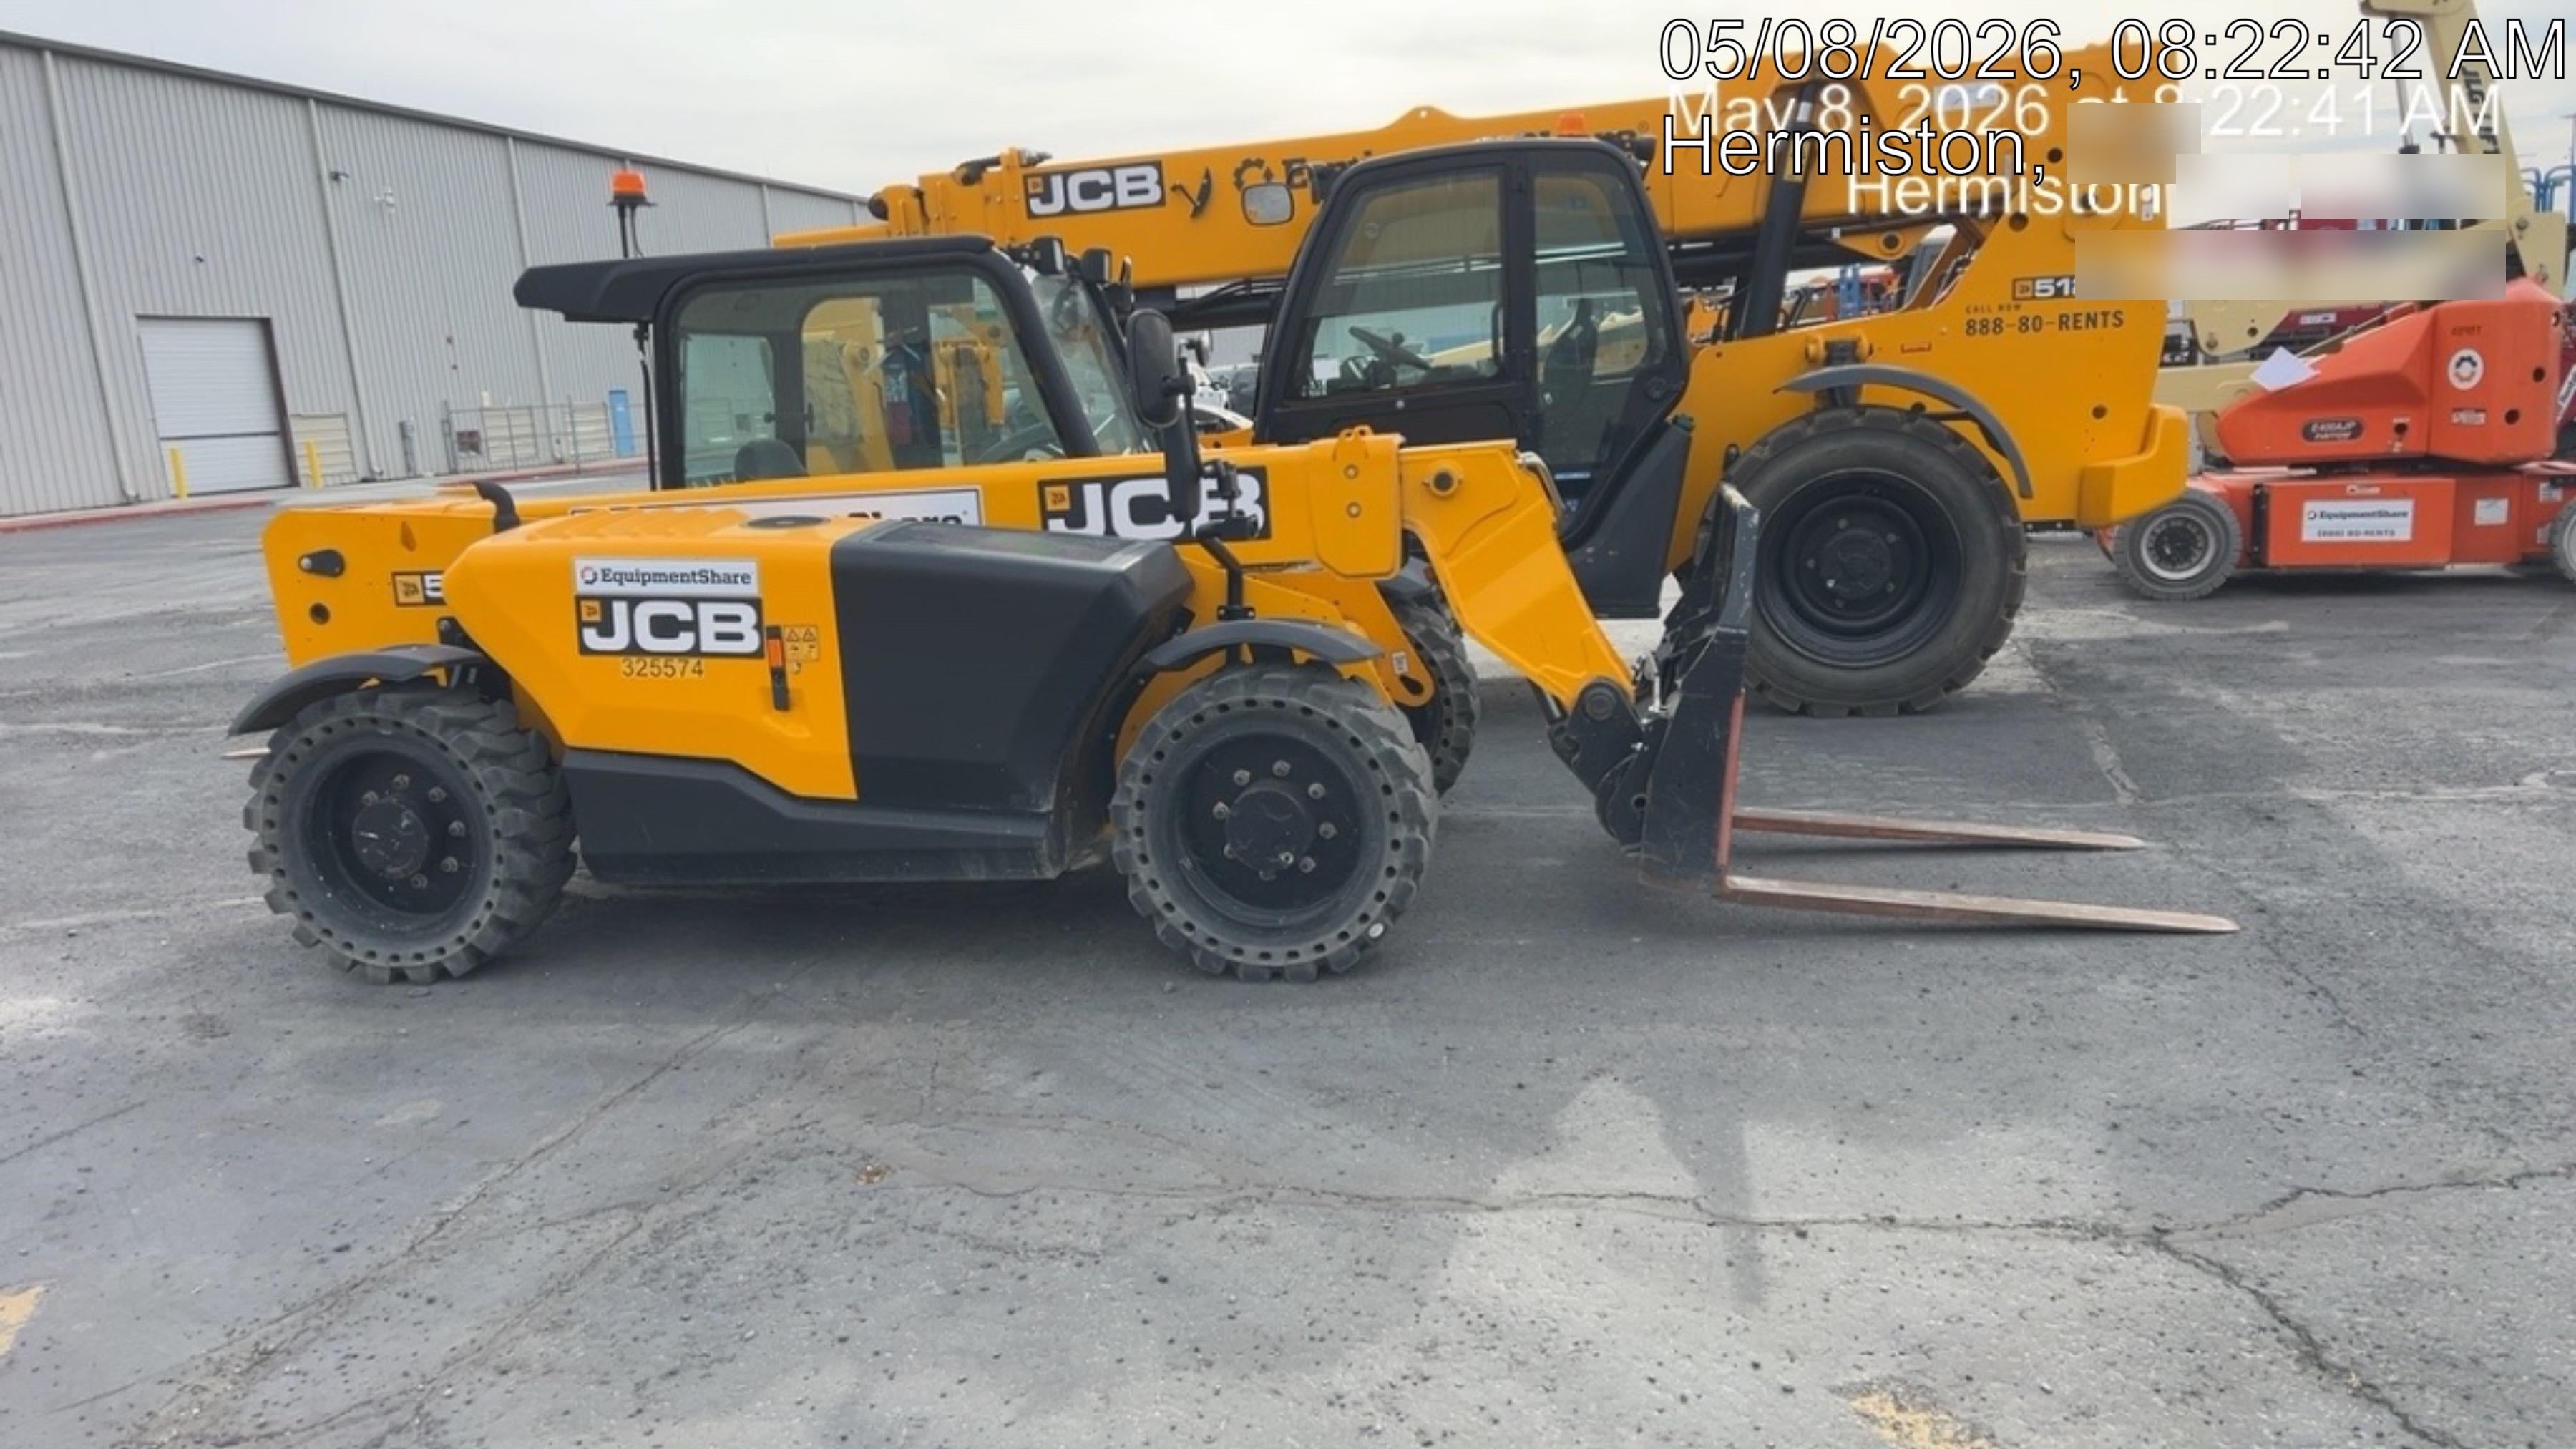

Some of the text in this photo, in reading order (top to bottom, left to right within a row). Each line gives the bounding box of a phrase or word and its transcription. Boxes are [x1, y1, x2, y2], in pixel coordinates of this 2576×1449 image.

[1030, 165, 1163, 215] JCB
[2034, 277, 2075, 297] 51
[1966, 310, 2124, 336] 888-80-RENTS
[1047, 473, 1265, 538] JCB
[601, 567, 751, 586] EquipmentShare
[582, 600, 761, 653] JCB
[622, 658, 703, 677] 325574
